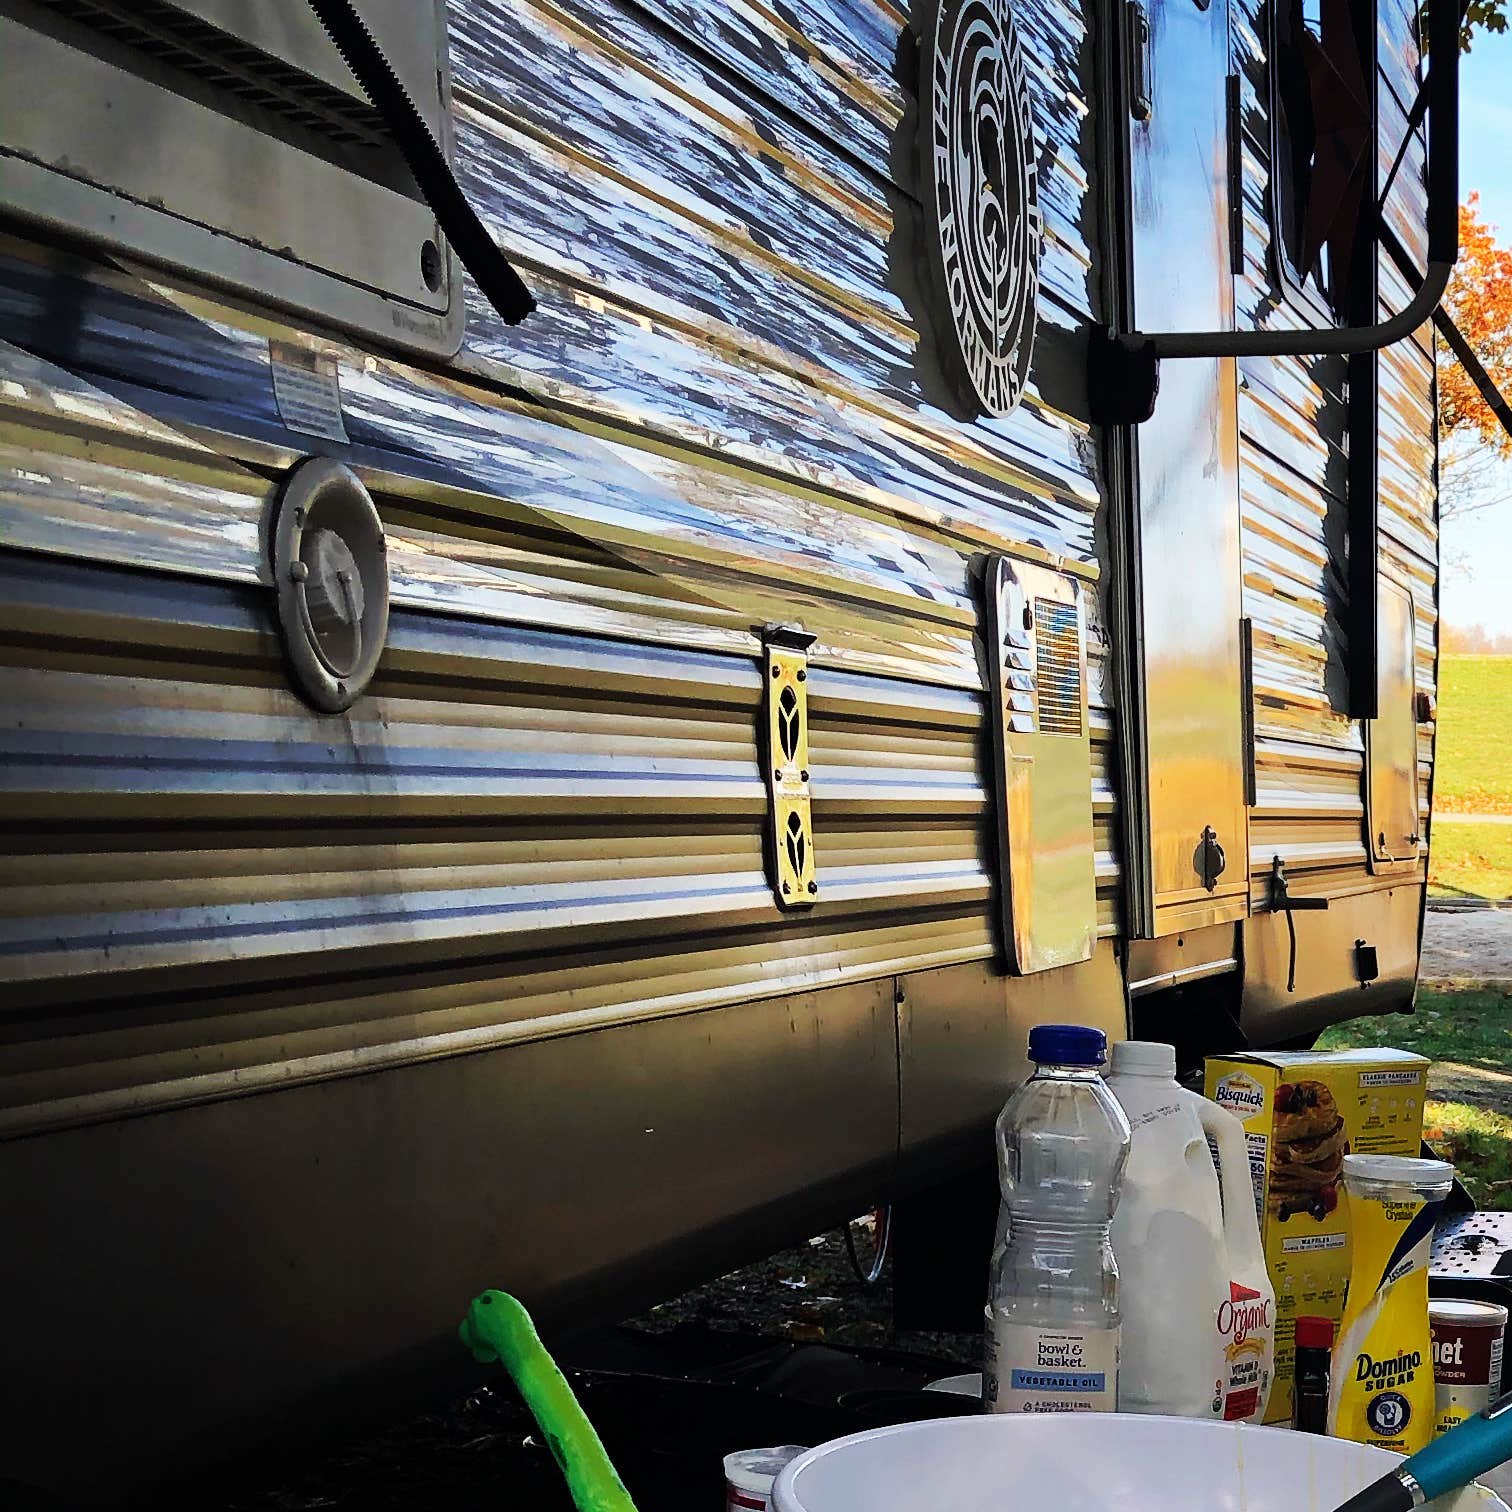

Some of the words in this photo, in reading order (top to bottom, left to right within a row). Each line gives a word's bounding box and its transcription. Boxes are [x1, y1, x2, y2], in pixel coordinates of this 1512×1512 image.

[935, 46, 952, 184] THE
[940, 213, 1021, 411] NORMANS
[1216, 1086, 1264, 1107] Bisquick
[1217, 1299, 1271, 1345] Organic
[1038, 1341, 1069, 1355] bowl
[1072, 1344, 1083, 1356] &
[1356, 1350, 1421, 1381] Domino
[1433, 1370, 1466, 1378] OWDER
[1019, 1375, 1078, 1387] VEGETABLE
[1082, 1379, 1098, 1387] OIL
[1365, 1371, 1414, 1392] SUGAR
